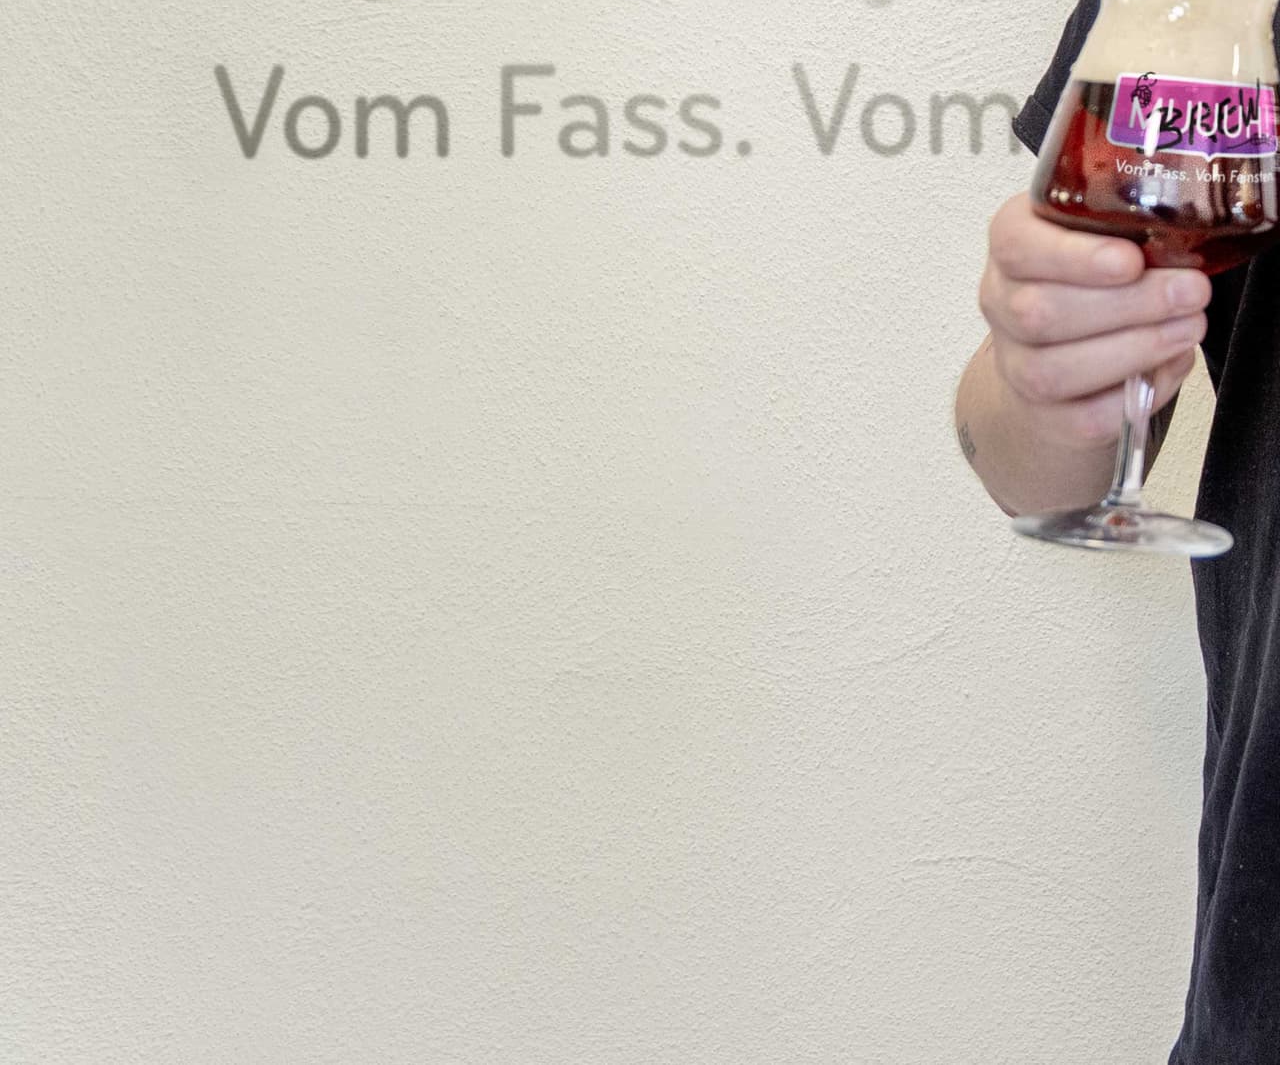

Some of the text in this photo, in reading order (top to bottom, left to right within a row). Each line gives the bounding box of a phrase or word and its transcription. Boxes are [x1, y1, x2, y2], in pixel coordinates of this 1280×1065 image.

[213, 62, 1022, 161] Vom Fass. Vom
[1116, 158, 1149, 176] Vom
[1153, 163, 1190, 182] Fass.
[1195, 168, 1226, 183] Vom
